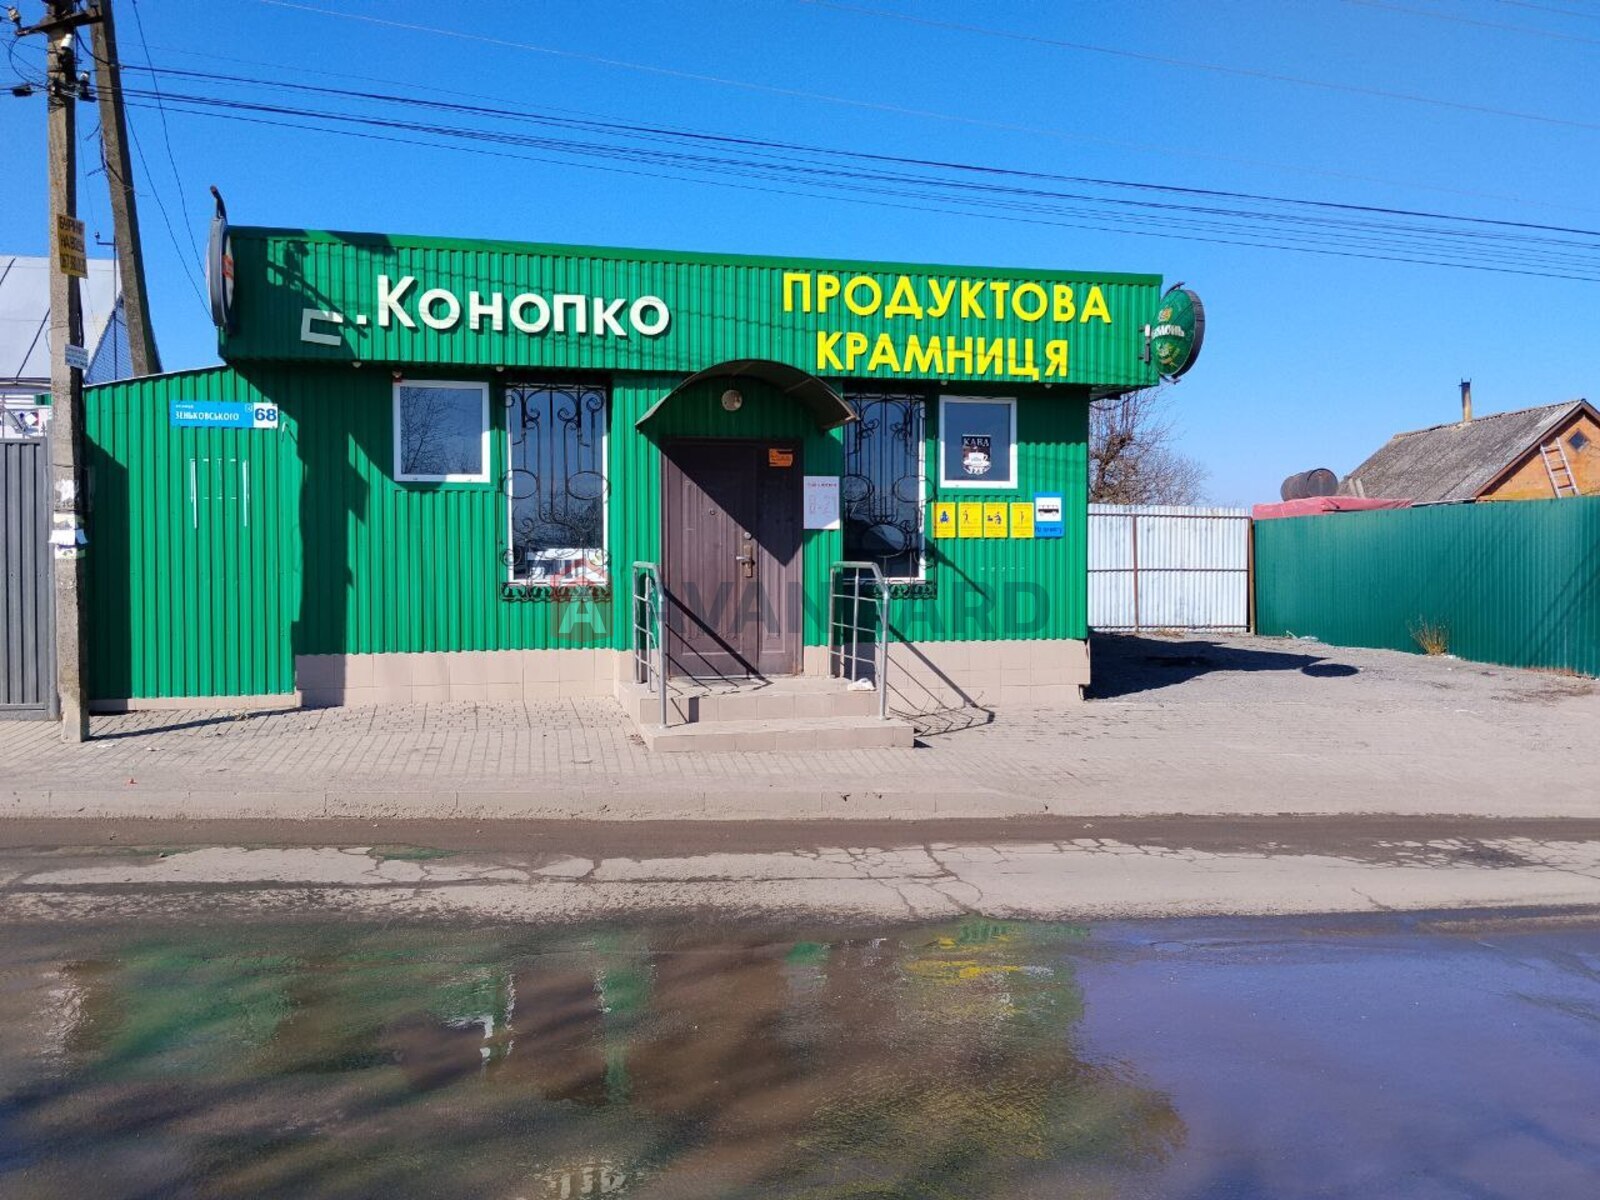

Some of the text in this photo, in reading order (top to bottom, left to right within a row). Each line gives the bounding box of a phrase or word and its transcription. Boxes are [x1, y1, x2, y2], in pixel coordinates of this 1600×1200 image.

[783, 272, 1112, 323] ПРОДУКТОВА
[817, 331, 1069, 381] КРАМНИЦЯ
[175, 407, 277, 422] ЗЕНЬКОВСЬКОГО 68
